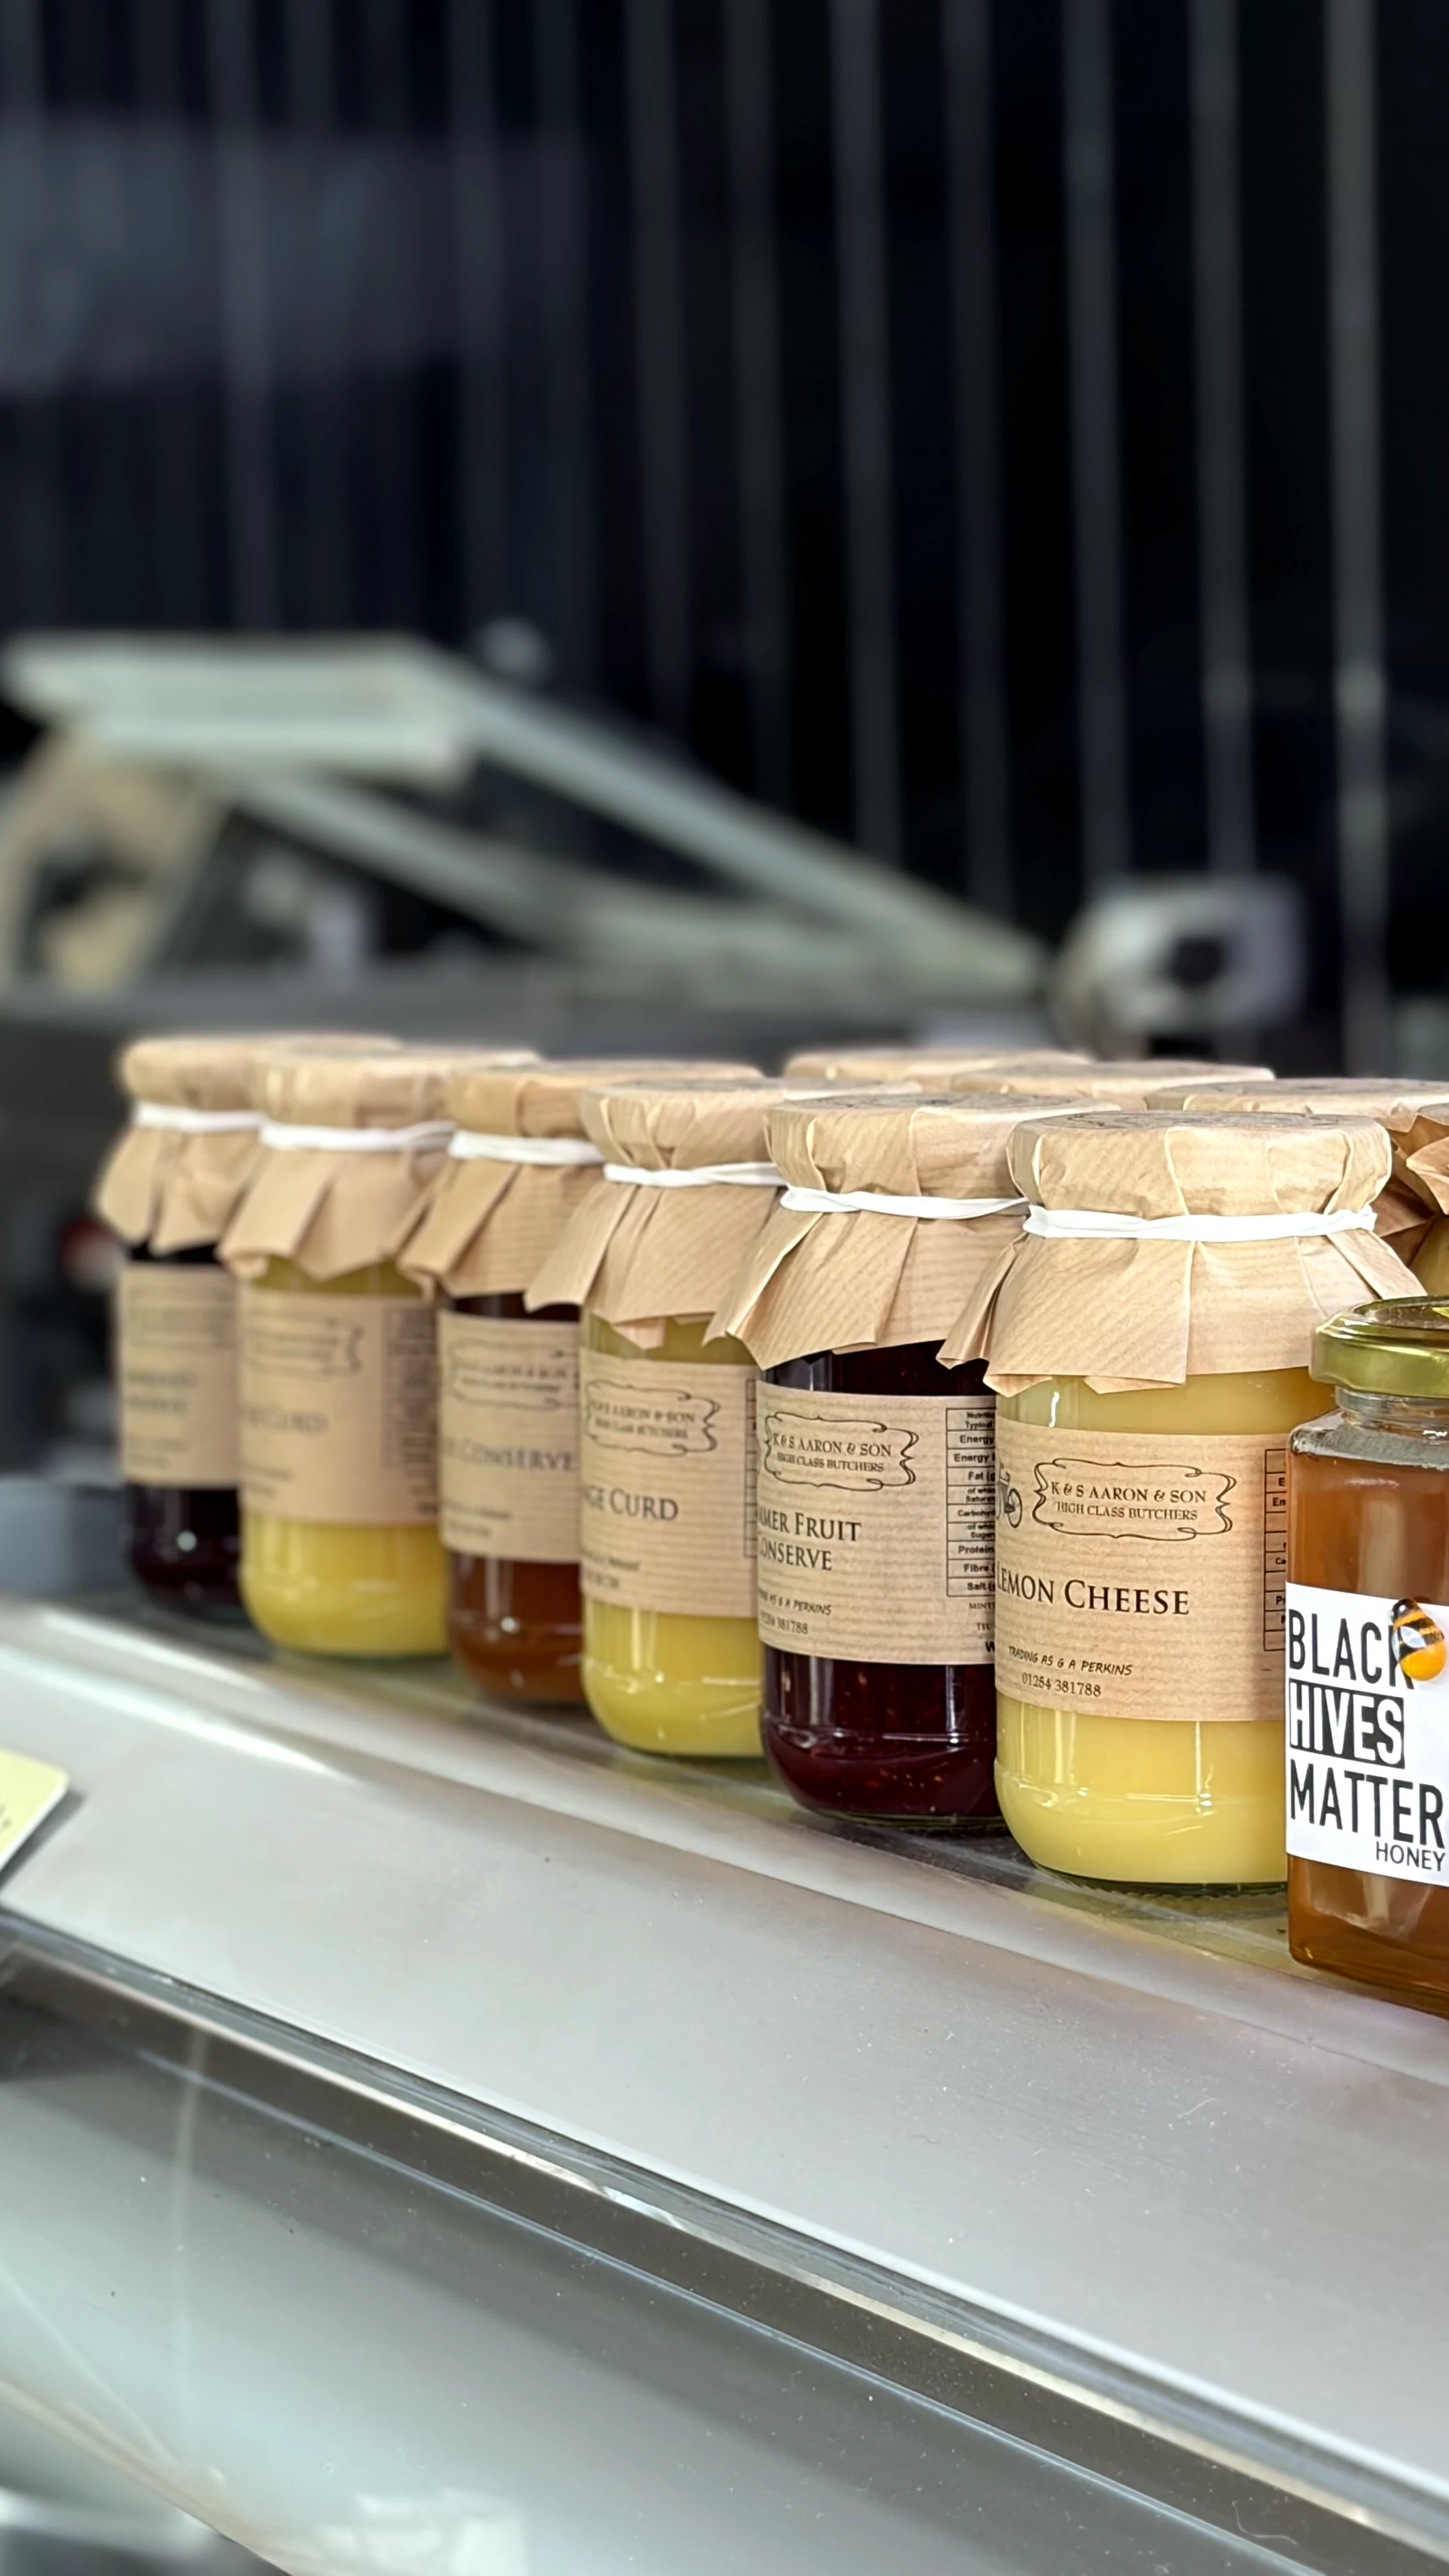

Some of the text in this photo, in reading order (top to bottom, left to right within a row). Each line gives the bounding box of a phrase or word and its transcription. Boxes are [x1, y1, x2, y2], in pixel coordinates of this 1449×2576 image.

[773, 1433, 781, 1446] K
[788, 1436, 795, 1449] S
[798, 1439, 842, 1454] AARON
[846, 1442, 856, 1455] &
[860, 1443, 892, 1458] SON
[960, 1435, 994, 1445] Energy
[796, 1455, 825, 1469] CLASS
[827, 1459, 885, 1473] BUTCHERS
[954, 1453, 989, 1464] Energy
[968, 1471, 984, 1481] Fat
[609, 1487, 679, 1521] CURD
[1051, 1481, 1207, 1504] K & S AARON & SON
[1056, 1501, 1198, 1521] HIGH CLASS BUTCHERS
[795, 1512, 862, 1542] FRUIT
[759, 1538, 832, 1571] ONSERVE
[958, 1545, 994, 1554] Protein
[964, 1563, 989, 1573] Fibre
[967, 1582, 986, 1591] Salt
[996, 1560, 1190, 1615] LEMON CHEESE
[793, 1599, 832, 1616] PERKINS
[1008, 1645, 1133, 1676] TRADING AS G A PERKINS
[1022, 1672, 1102, 1698] 01254 381788
[1290, 1681, 1403, 1765] HIVES
[1290, 1758, 1446, 1850] MATTER
[1376, 1840, 1446, 1872] HONEY
